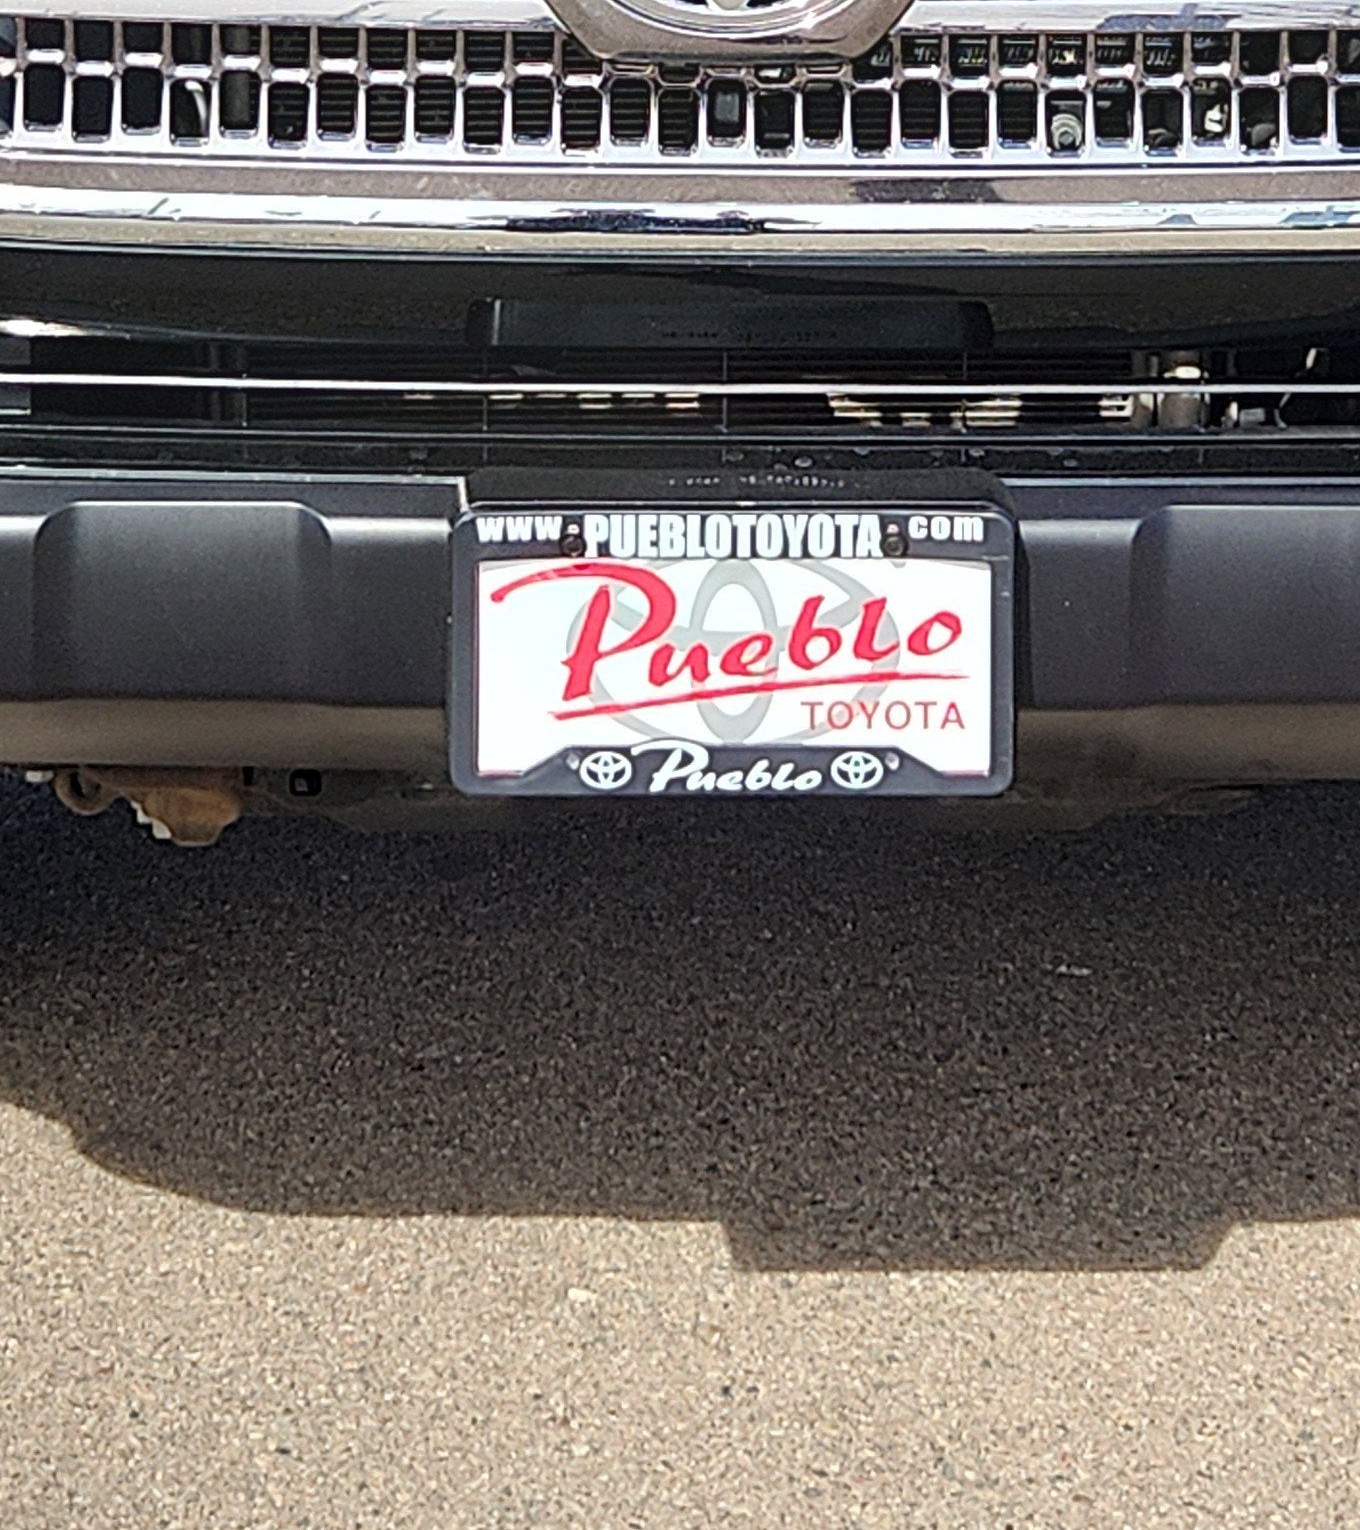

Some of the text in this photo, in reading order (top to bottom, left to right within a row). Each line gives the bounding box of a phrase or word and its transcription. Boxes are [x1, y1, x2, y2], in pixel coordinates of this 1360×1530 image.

[490, 563, 963, 701] Pueblo
[800, 701, 966, 730] TOYOTA
[631, 738, 823, 793] Pueblo
